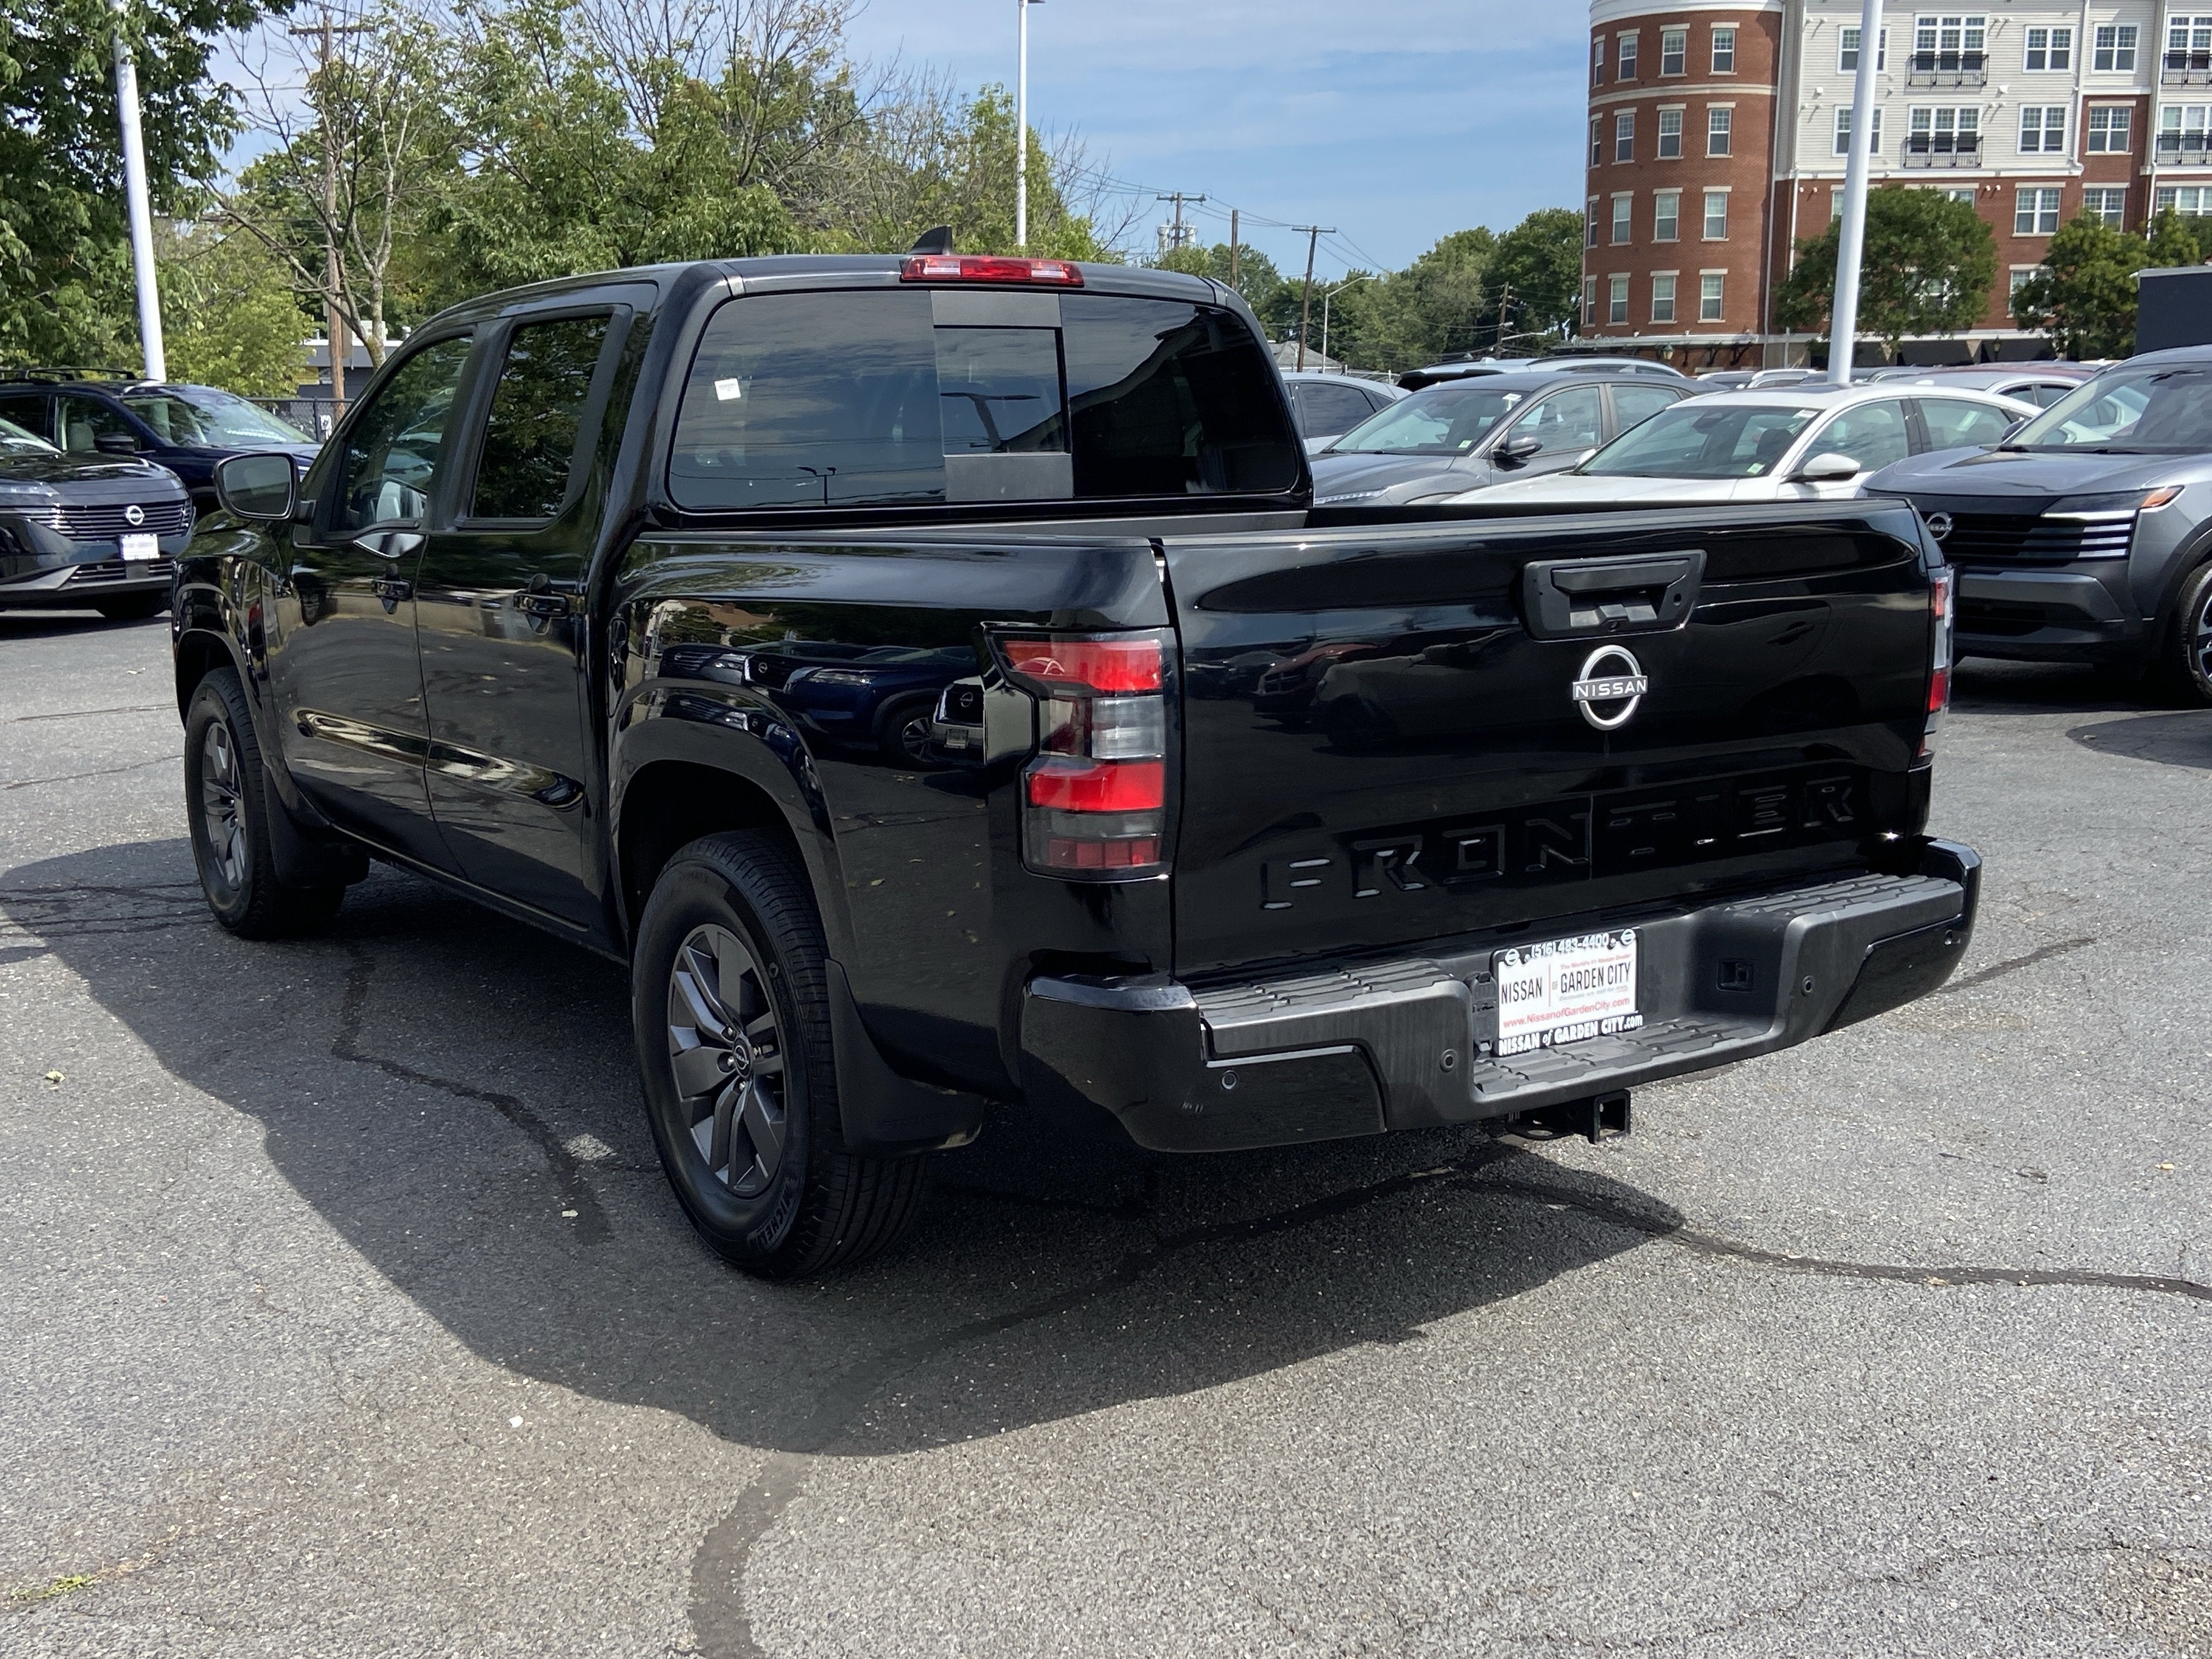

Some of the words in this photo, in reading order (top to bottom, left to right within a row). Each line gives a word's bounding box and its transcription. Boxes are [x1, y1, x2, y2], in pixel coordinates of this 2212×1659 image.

[1576, 679, 1645, 698] NISSAN
[1260, 775, 1855, 910] FRONTIER
[1531, 941, 1556, 958] (516)
[1557, 933, 1610, 953] 483-4400
[1501, 976, 1543, 1005] NISSAN
[1561, 967, 1604, 994] GARDEN
[1607, 961, 1631, 985] CITY
[1503, 997, 1630, 1028] www.NissanofGardenCity.com
[1499, 1032, 1541, 1056] NISSAN
[1542, 1029, 1554, 1046] of
[1554, 1020, 1599, 1043] GARDEN
[1601, 1014, 1643, 1034] CITY.com
